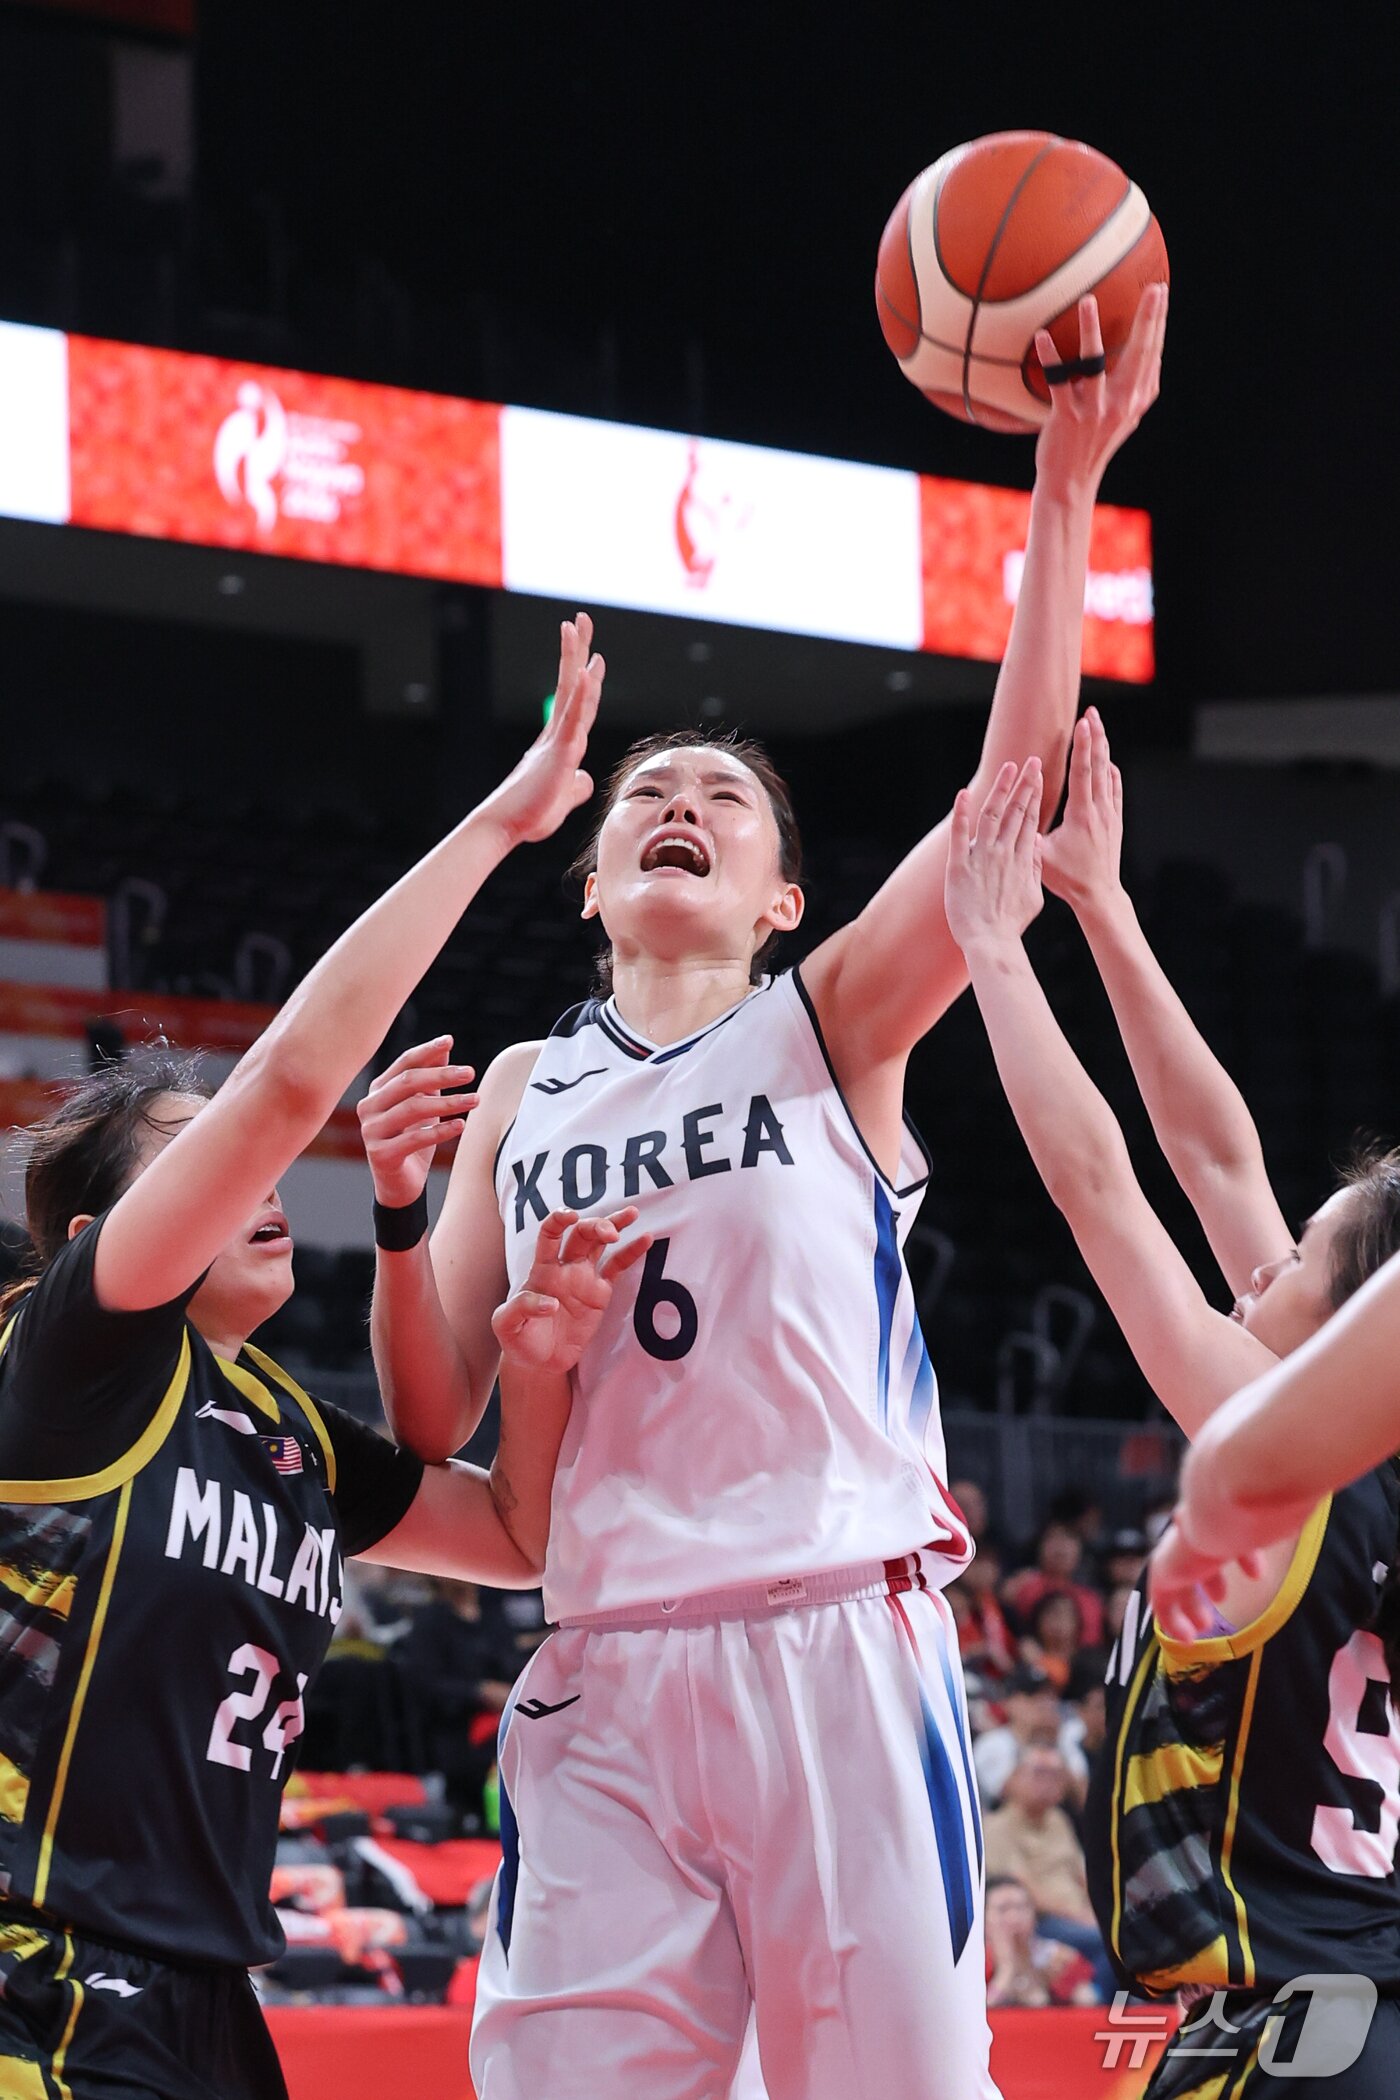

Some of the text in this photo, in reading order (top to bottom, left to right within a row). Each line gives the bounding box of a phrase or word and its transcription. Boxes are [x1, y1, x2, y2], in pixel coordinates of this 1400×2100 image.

[512, 1095, 795, 1234] KOREA
[634, 1237, 698, 1361] 6
[206, 1643, 308, 1781] 24
